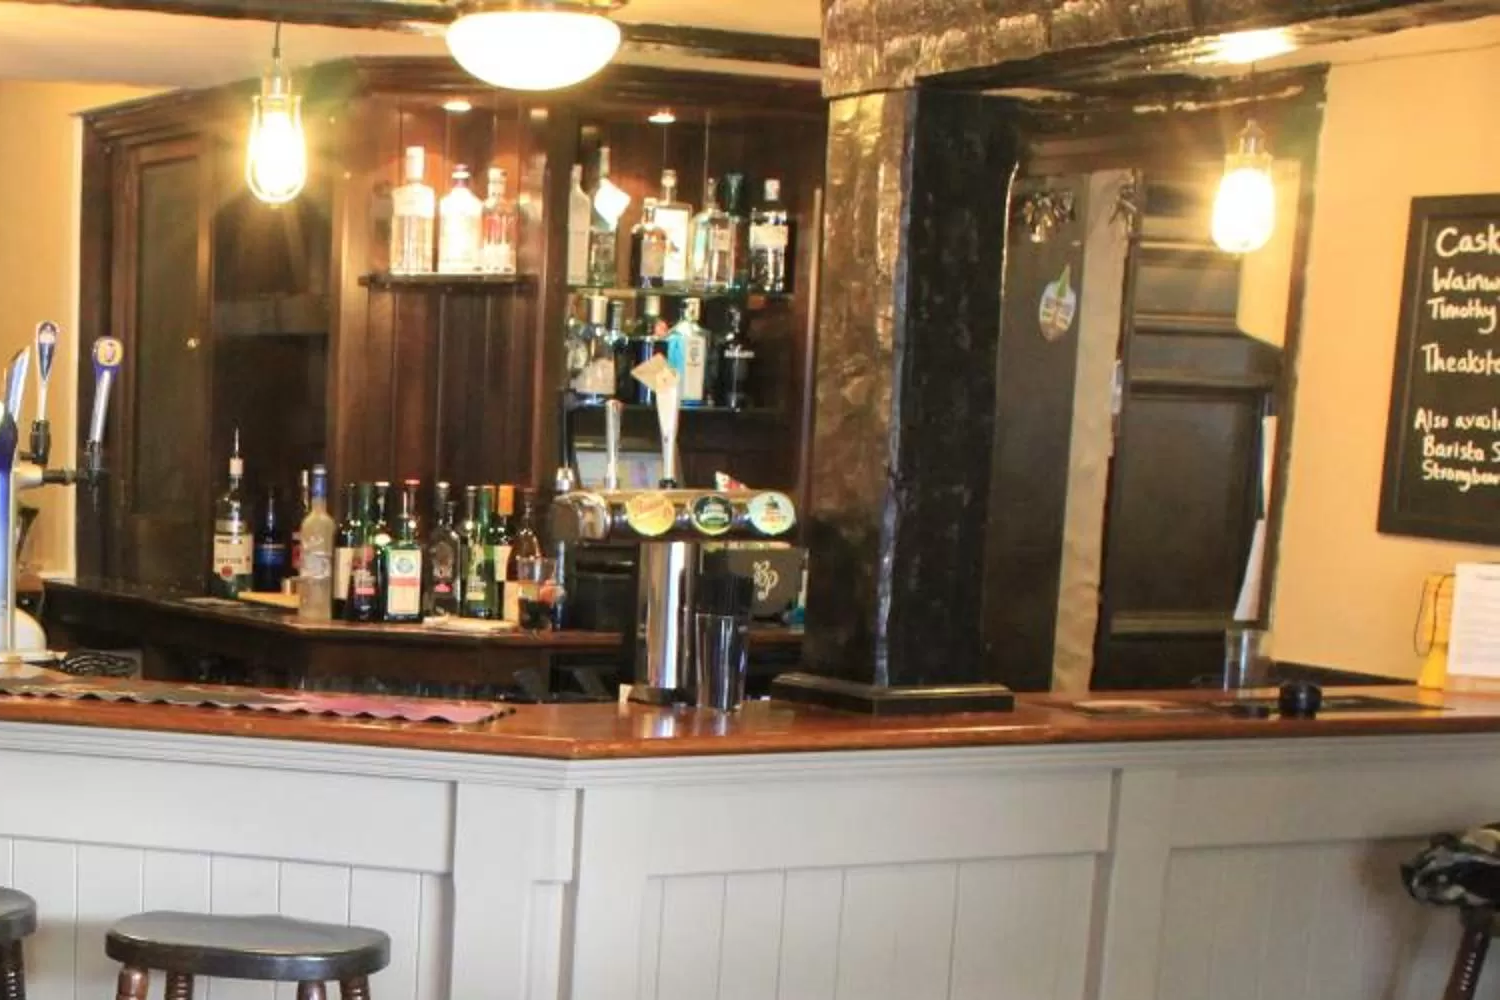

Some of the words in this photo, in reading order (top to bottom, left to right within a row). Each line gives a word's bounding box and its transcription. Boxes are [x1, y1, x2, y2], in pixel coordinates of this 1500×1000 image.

[1426, 296, 1497, 335] Timothy
[1413, 407, 1449, 433] Also
[1422, 434, 1485, 462] Barista
